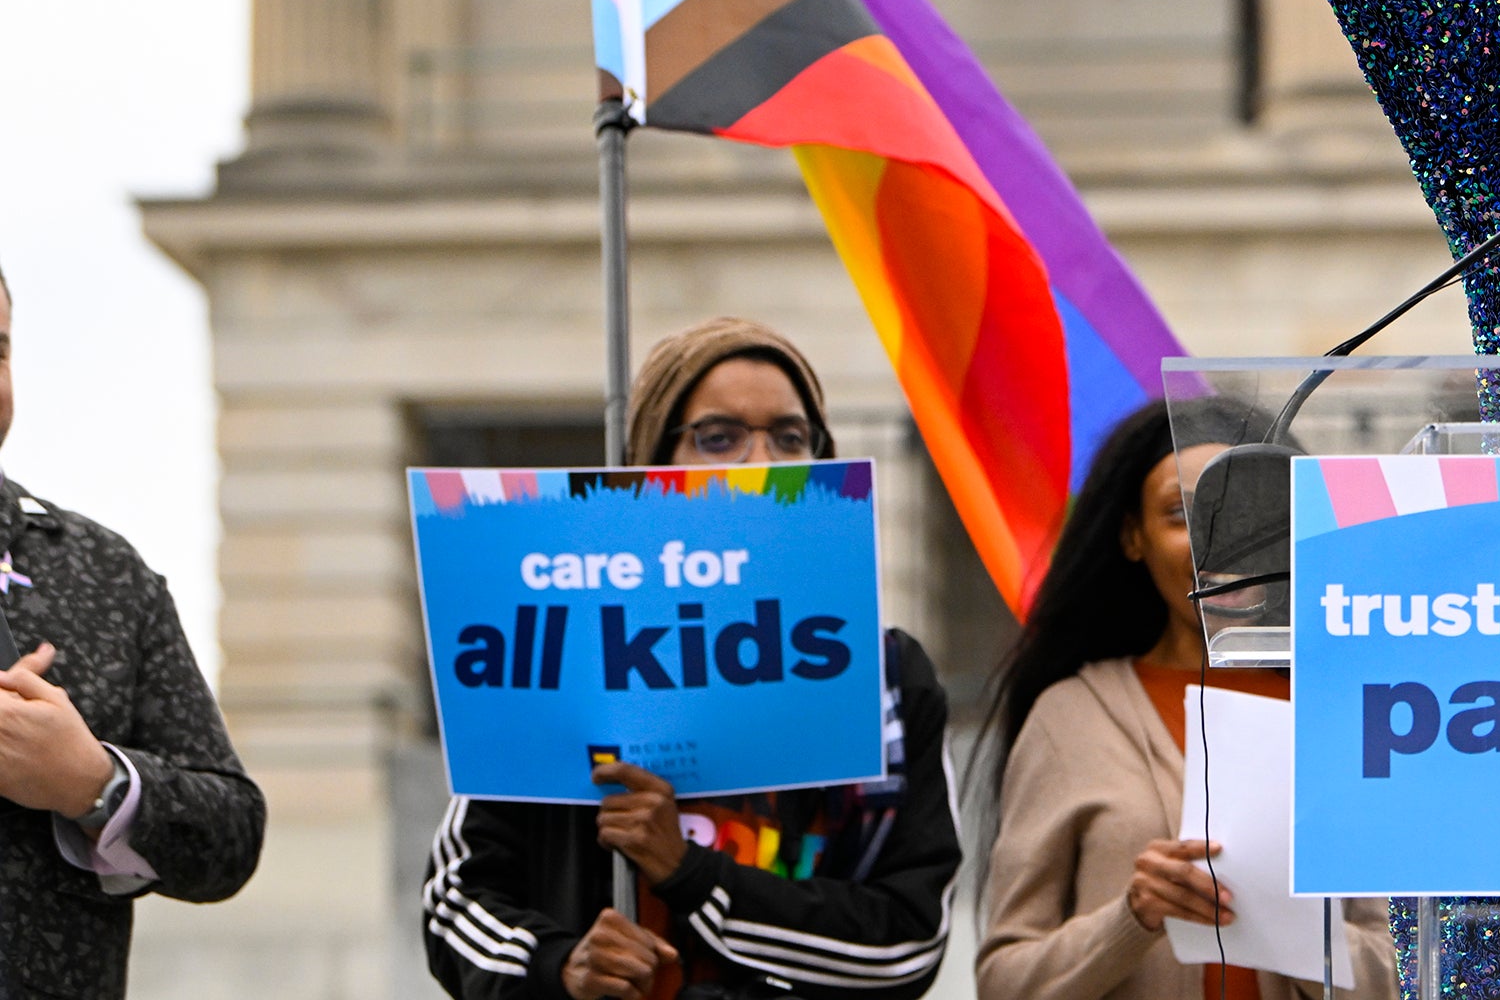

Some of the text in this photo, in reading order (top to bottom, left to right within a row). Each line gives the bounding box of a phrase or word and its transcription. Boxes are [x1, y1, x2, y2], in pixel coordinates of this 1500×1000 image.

[520, 540, 749, 590] care for
[1321, 583, 1500, 637] trust
[453, 598, 852, 691] all kids
